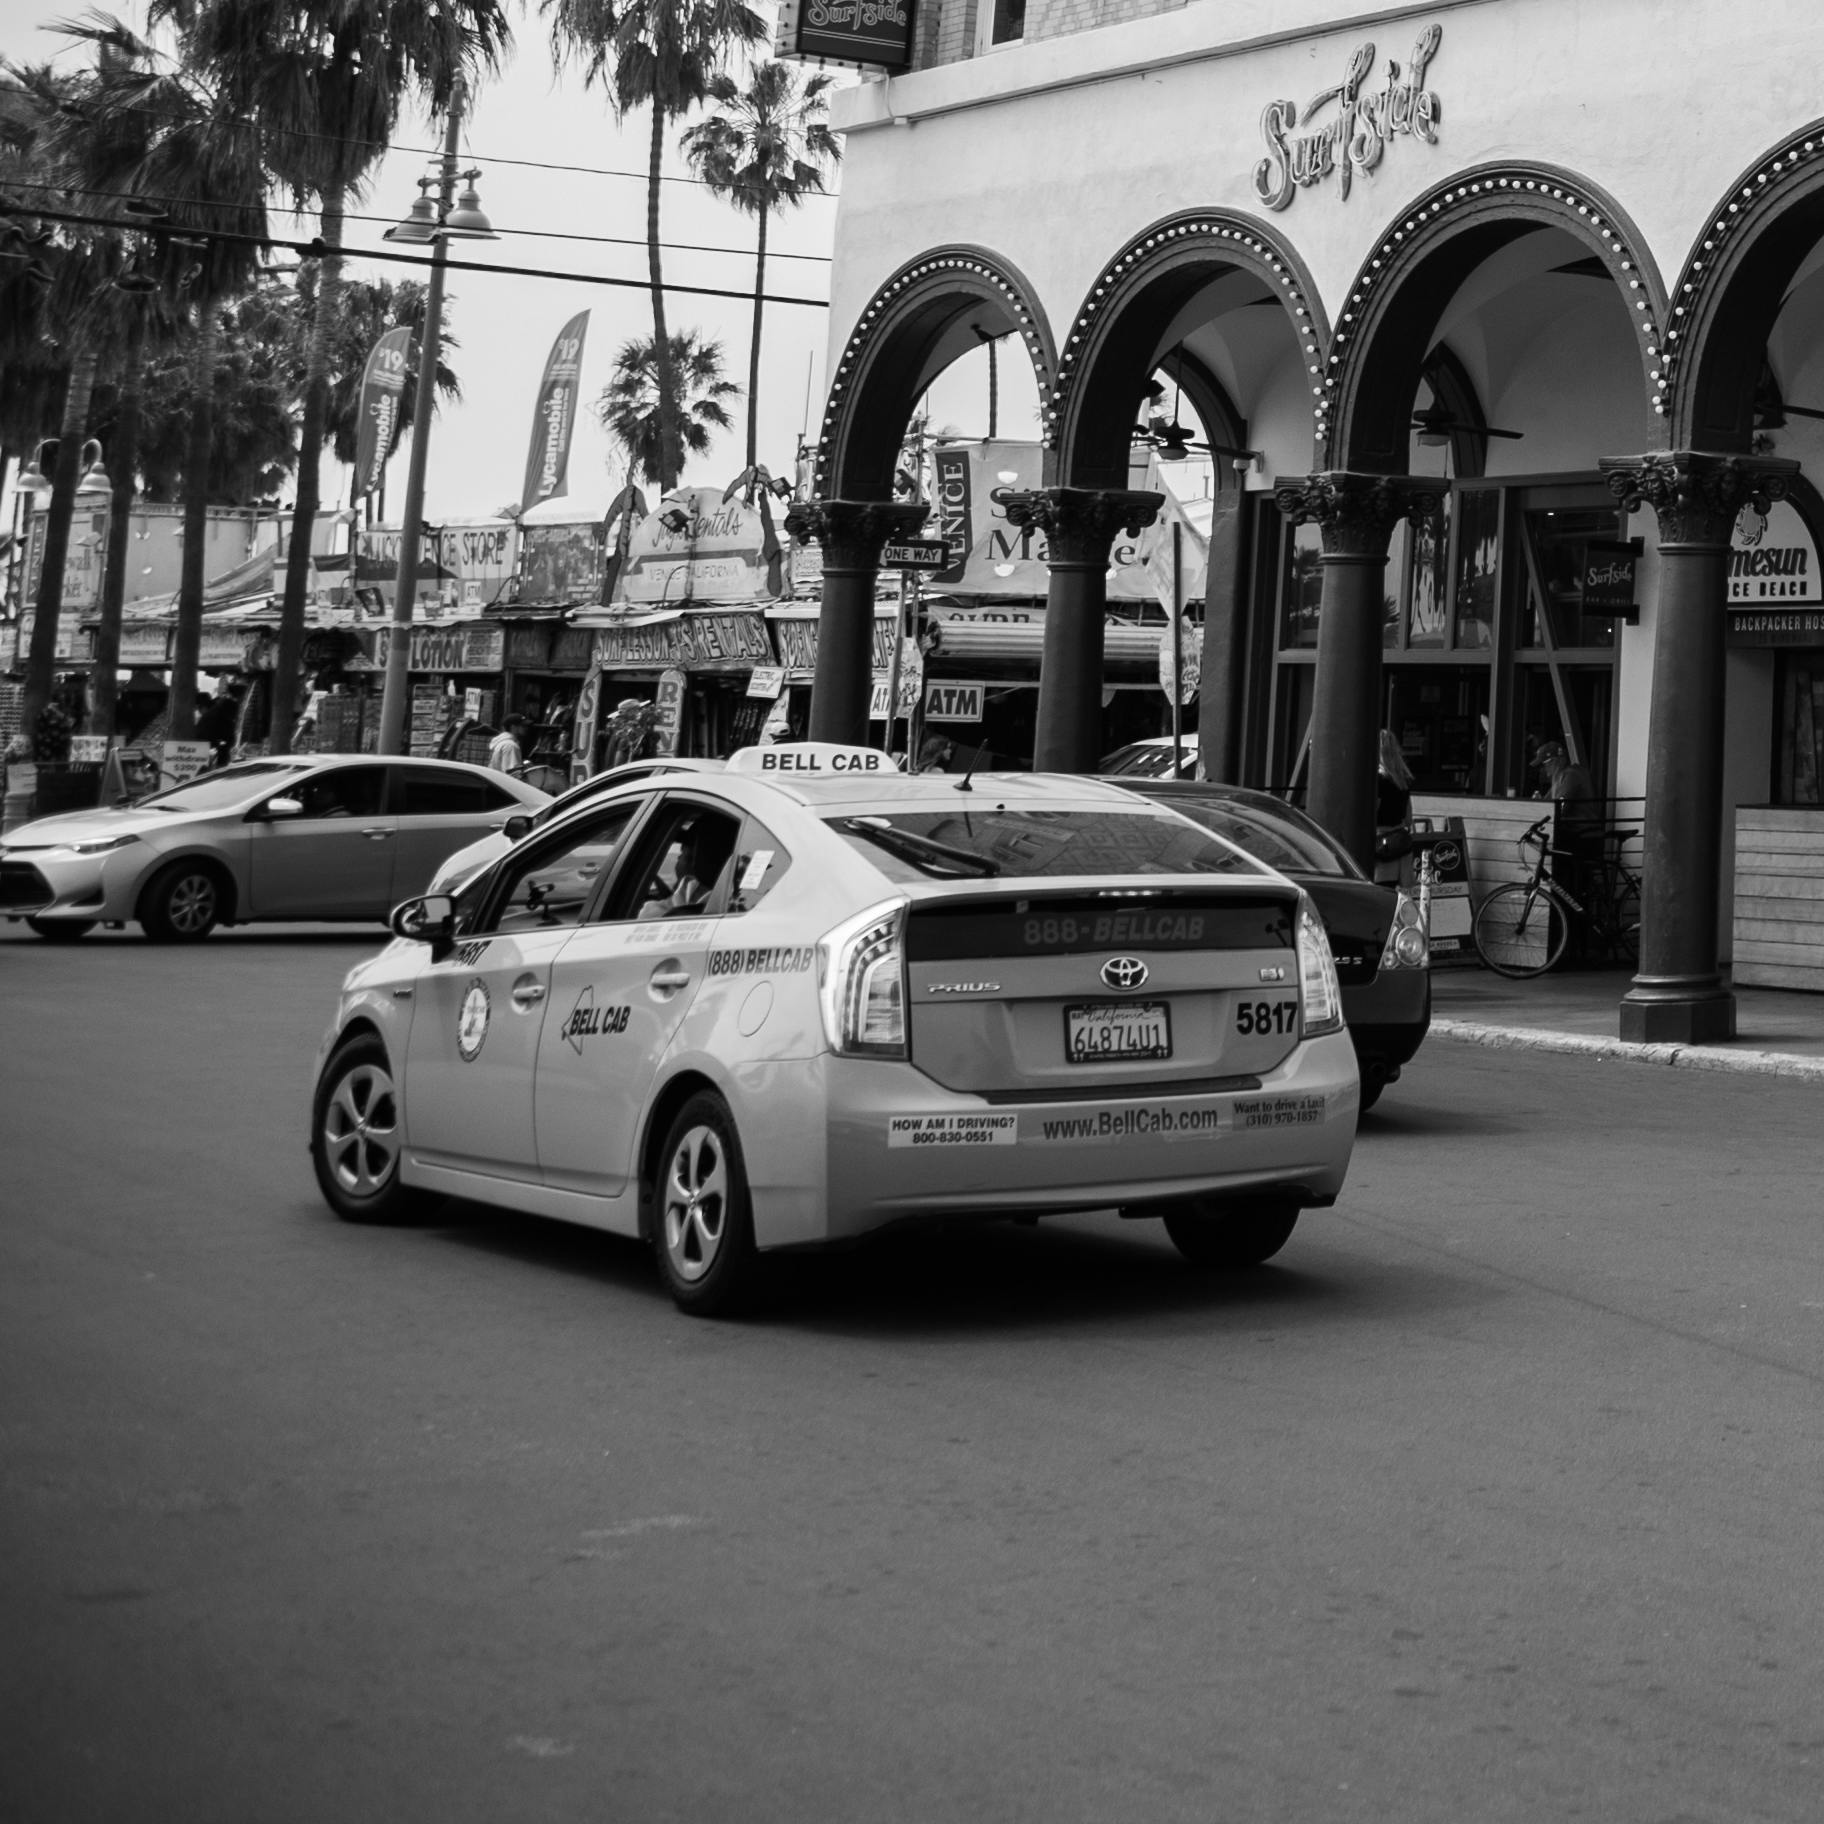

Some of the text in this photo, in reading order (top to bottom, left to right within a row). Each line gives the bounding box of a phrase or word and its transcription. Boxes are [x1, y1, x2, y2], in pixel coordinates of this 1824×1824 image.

[1253, 23, 1442, 210] Surfside
[538, 386, 565, 497] Lycamobile
[941, 461, 966, 573] VENICE
[463, 531, 505, 566] STORE
[885, 546, 940, 562] ONE WAY
[1587, 562, 1633, 587] Surfside
[1759, 580, 1807, 597] BEACH
[1734, 615, 1802, 632] BACKPACKER
[411, 640, 465, 669] LOTION
[925, 688, 978, 716] ATM
[762, 753, 880, 771] BELL CAB
[707, 947, 814, 976] (888) BELLCAB
[927, 982, 1001, 994] PRIUS
[569, 1005, 631, 1036] BELL CAB
[1236, 1001, 1298, 1036] 5817
[1074, 1023, 1160, 1053] 64874U1
[1233, 1102, 1260, 1114] Want
[1262, 1101, 1273, 1112] to
[1274, 1098, 1298, 1112] drive
[892, 1115, 1016, 1131] HOW AM I DRIVING?
[1043, 1107, 1219, 1141] www.BellCab.com
[1246, 1113, 1273, 1128] (310)
[912, 1131, 994, 1145] 800-830-0551
